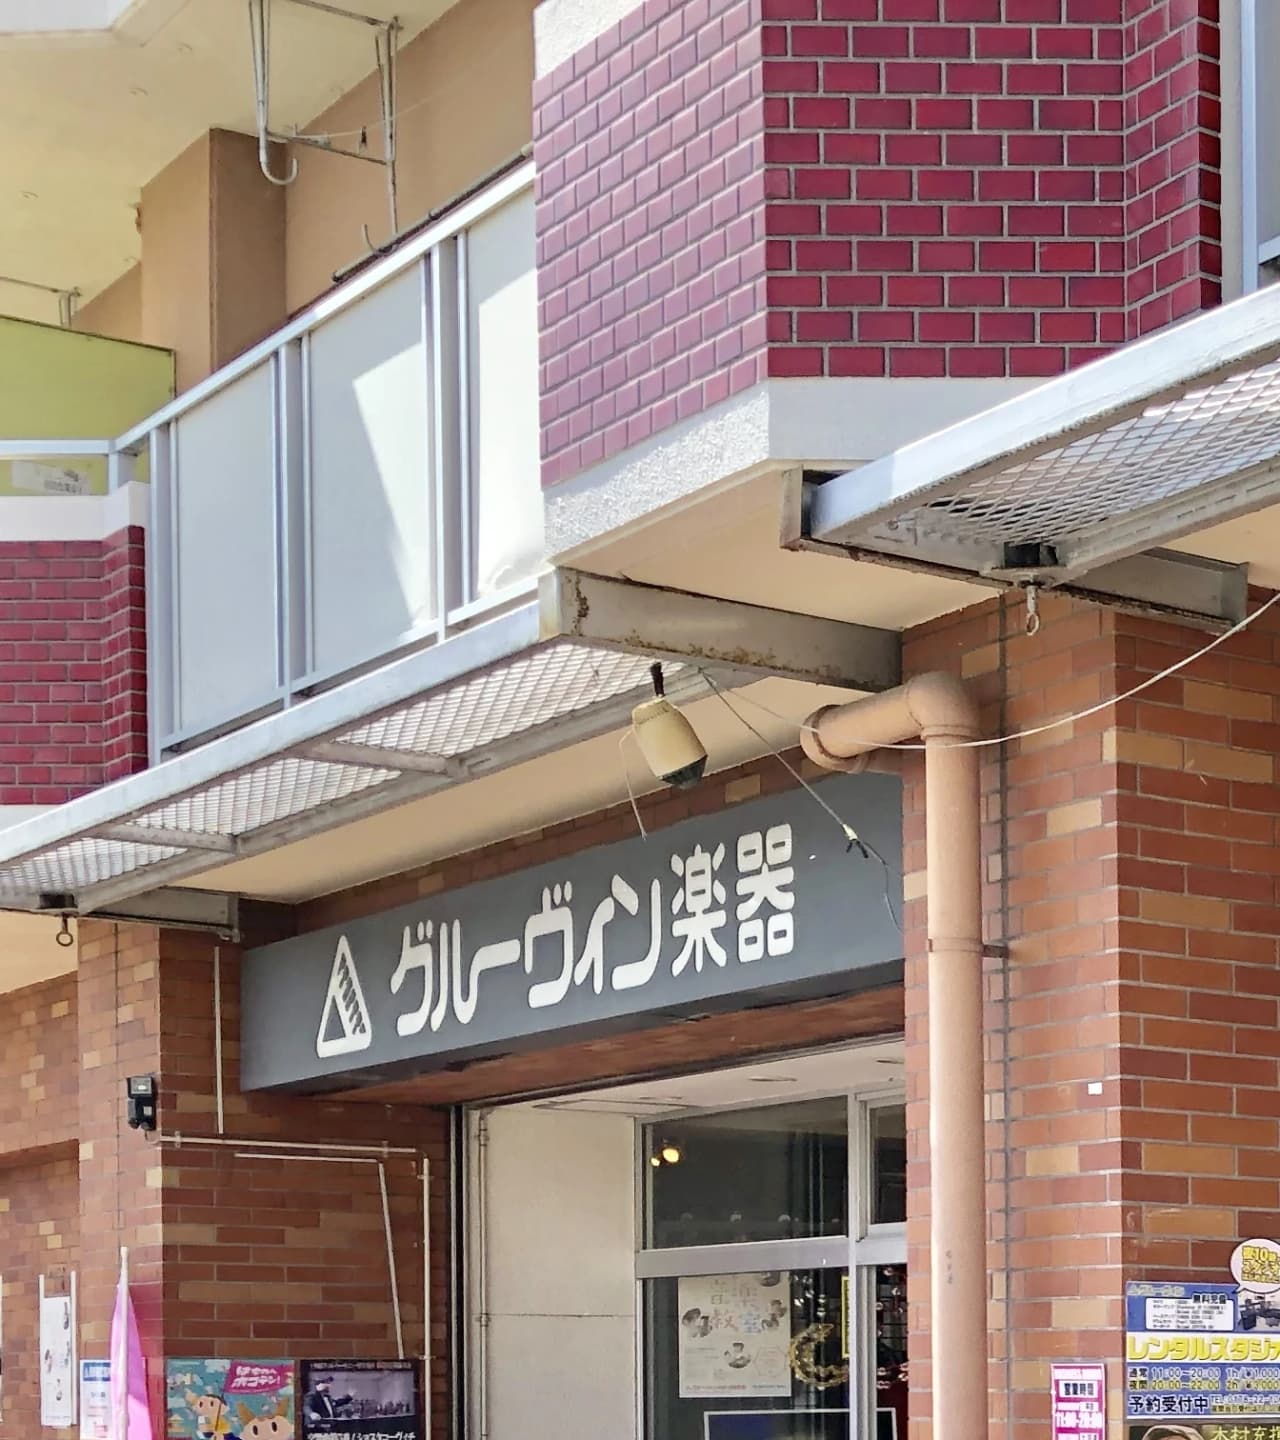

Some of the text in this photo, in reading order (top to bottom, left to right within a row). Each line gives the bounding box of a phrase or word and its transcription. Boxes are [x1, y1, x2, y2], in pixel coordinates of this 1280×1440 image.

[391, 823, 794, 1036] グルーヴィン楽器
[1129, 1396, 1209, 1413] 予約受付中
